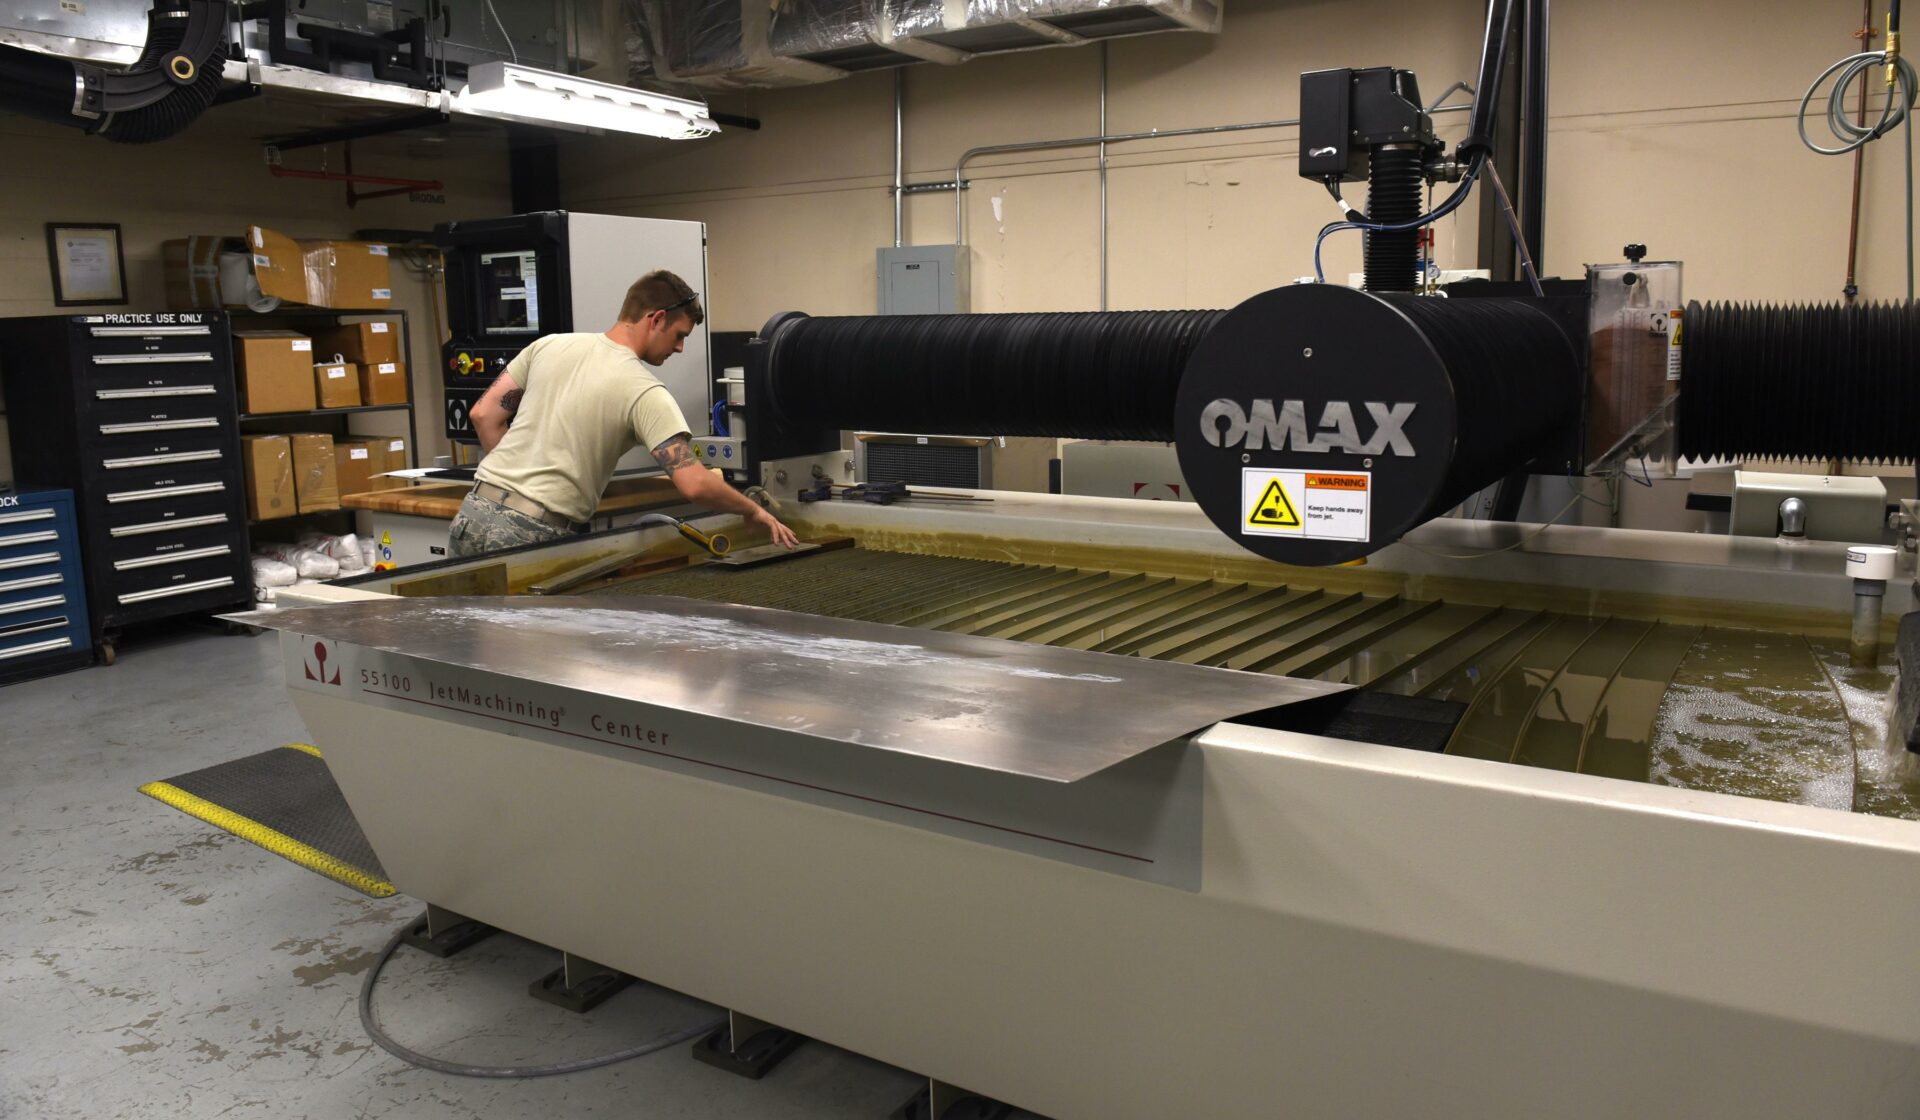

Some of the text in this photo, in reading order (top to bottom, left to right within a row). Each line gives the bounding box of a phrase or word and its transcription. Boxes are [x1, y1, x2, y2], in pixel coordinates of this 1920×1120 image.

[105, 313, 202, 323] PRACTICE USE ONLY
[1200, 398, 1417, 457] OMAX
[1319, 477, 1366, 488] WARNING
[1308, 505, 1324, 513] Keep
[361, 669, 411, 692] 55100
[591, 714, 669, 745] Center
